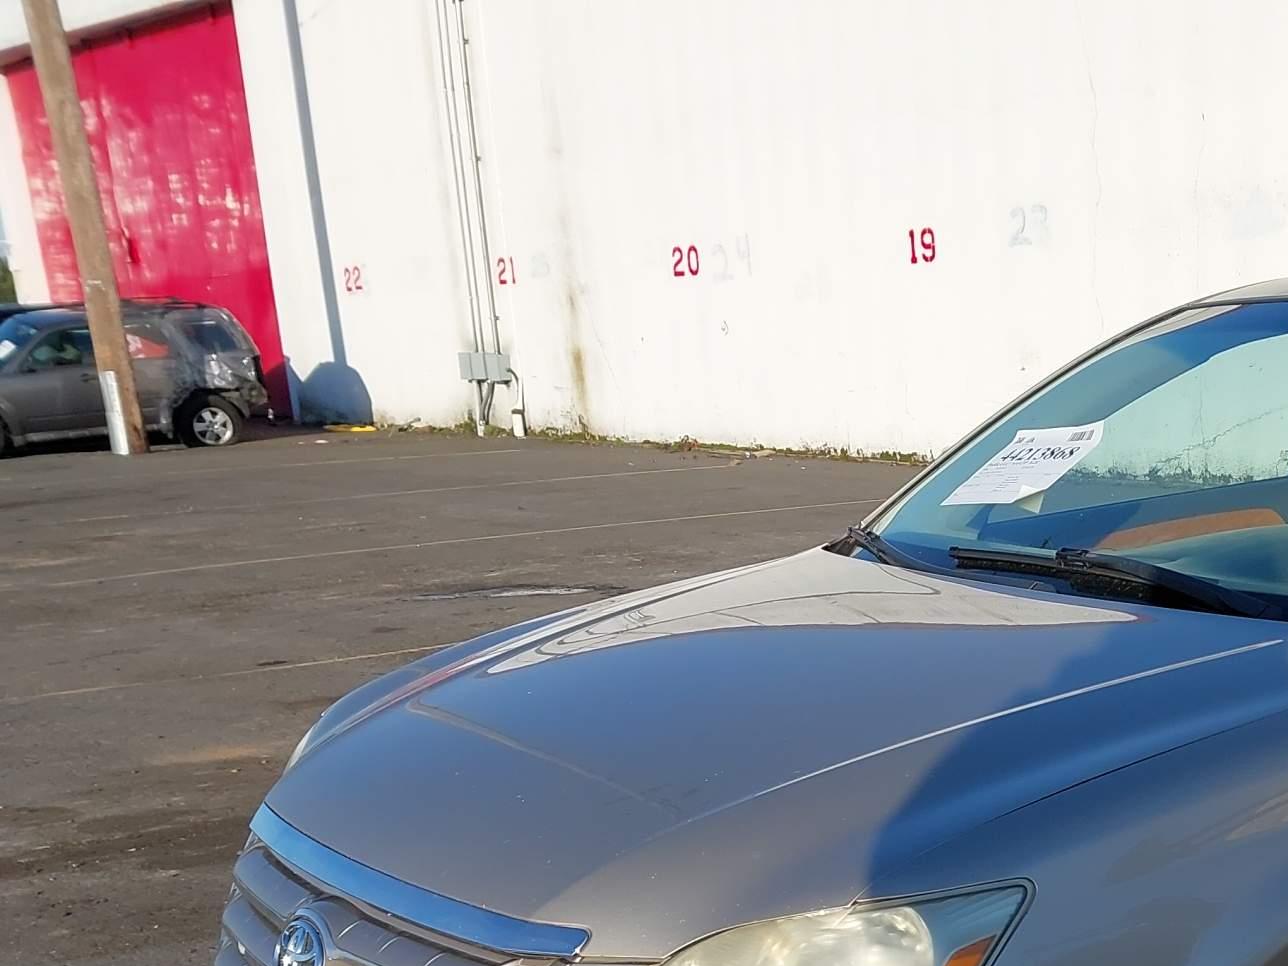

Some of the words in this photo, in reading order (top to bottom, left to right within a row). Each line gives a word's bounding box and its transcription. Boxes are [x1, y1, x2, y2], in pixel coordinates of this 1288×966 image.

[908, 227, 936, 265] 19
[497, 256, 516, 285] 21
[672, 245, 700, 277] 20
[344, 266, 363, 292] 22
[1000, 446, 1081, 461] 44213868
